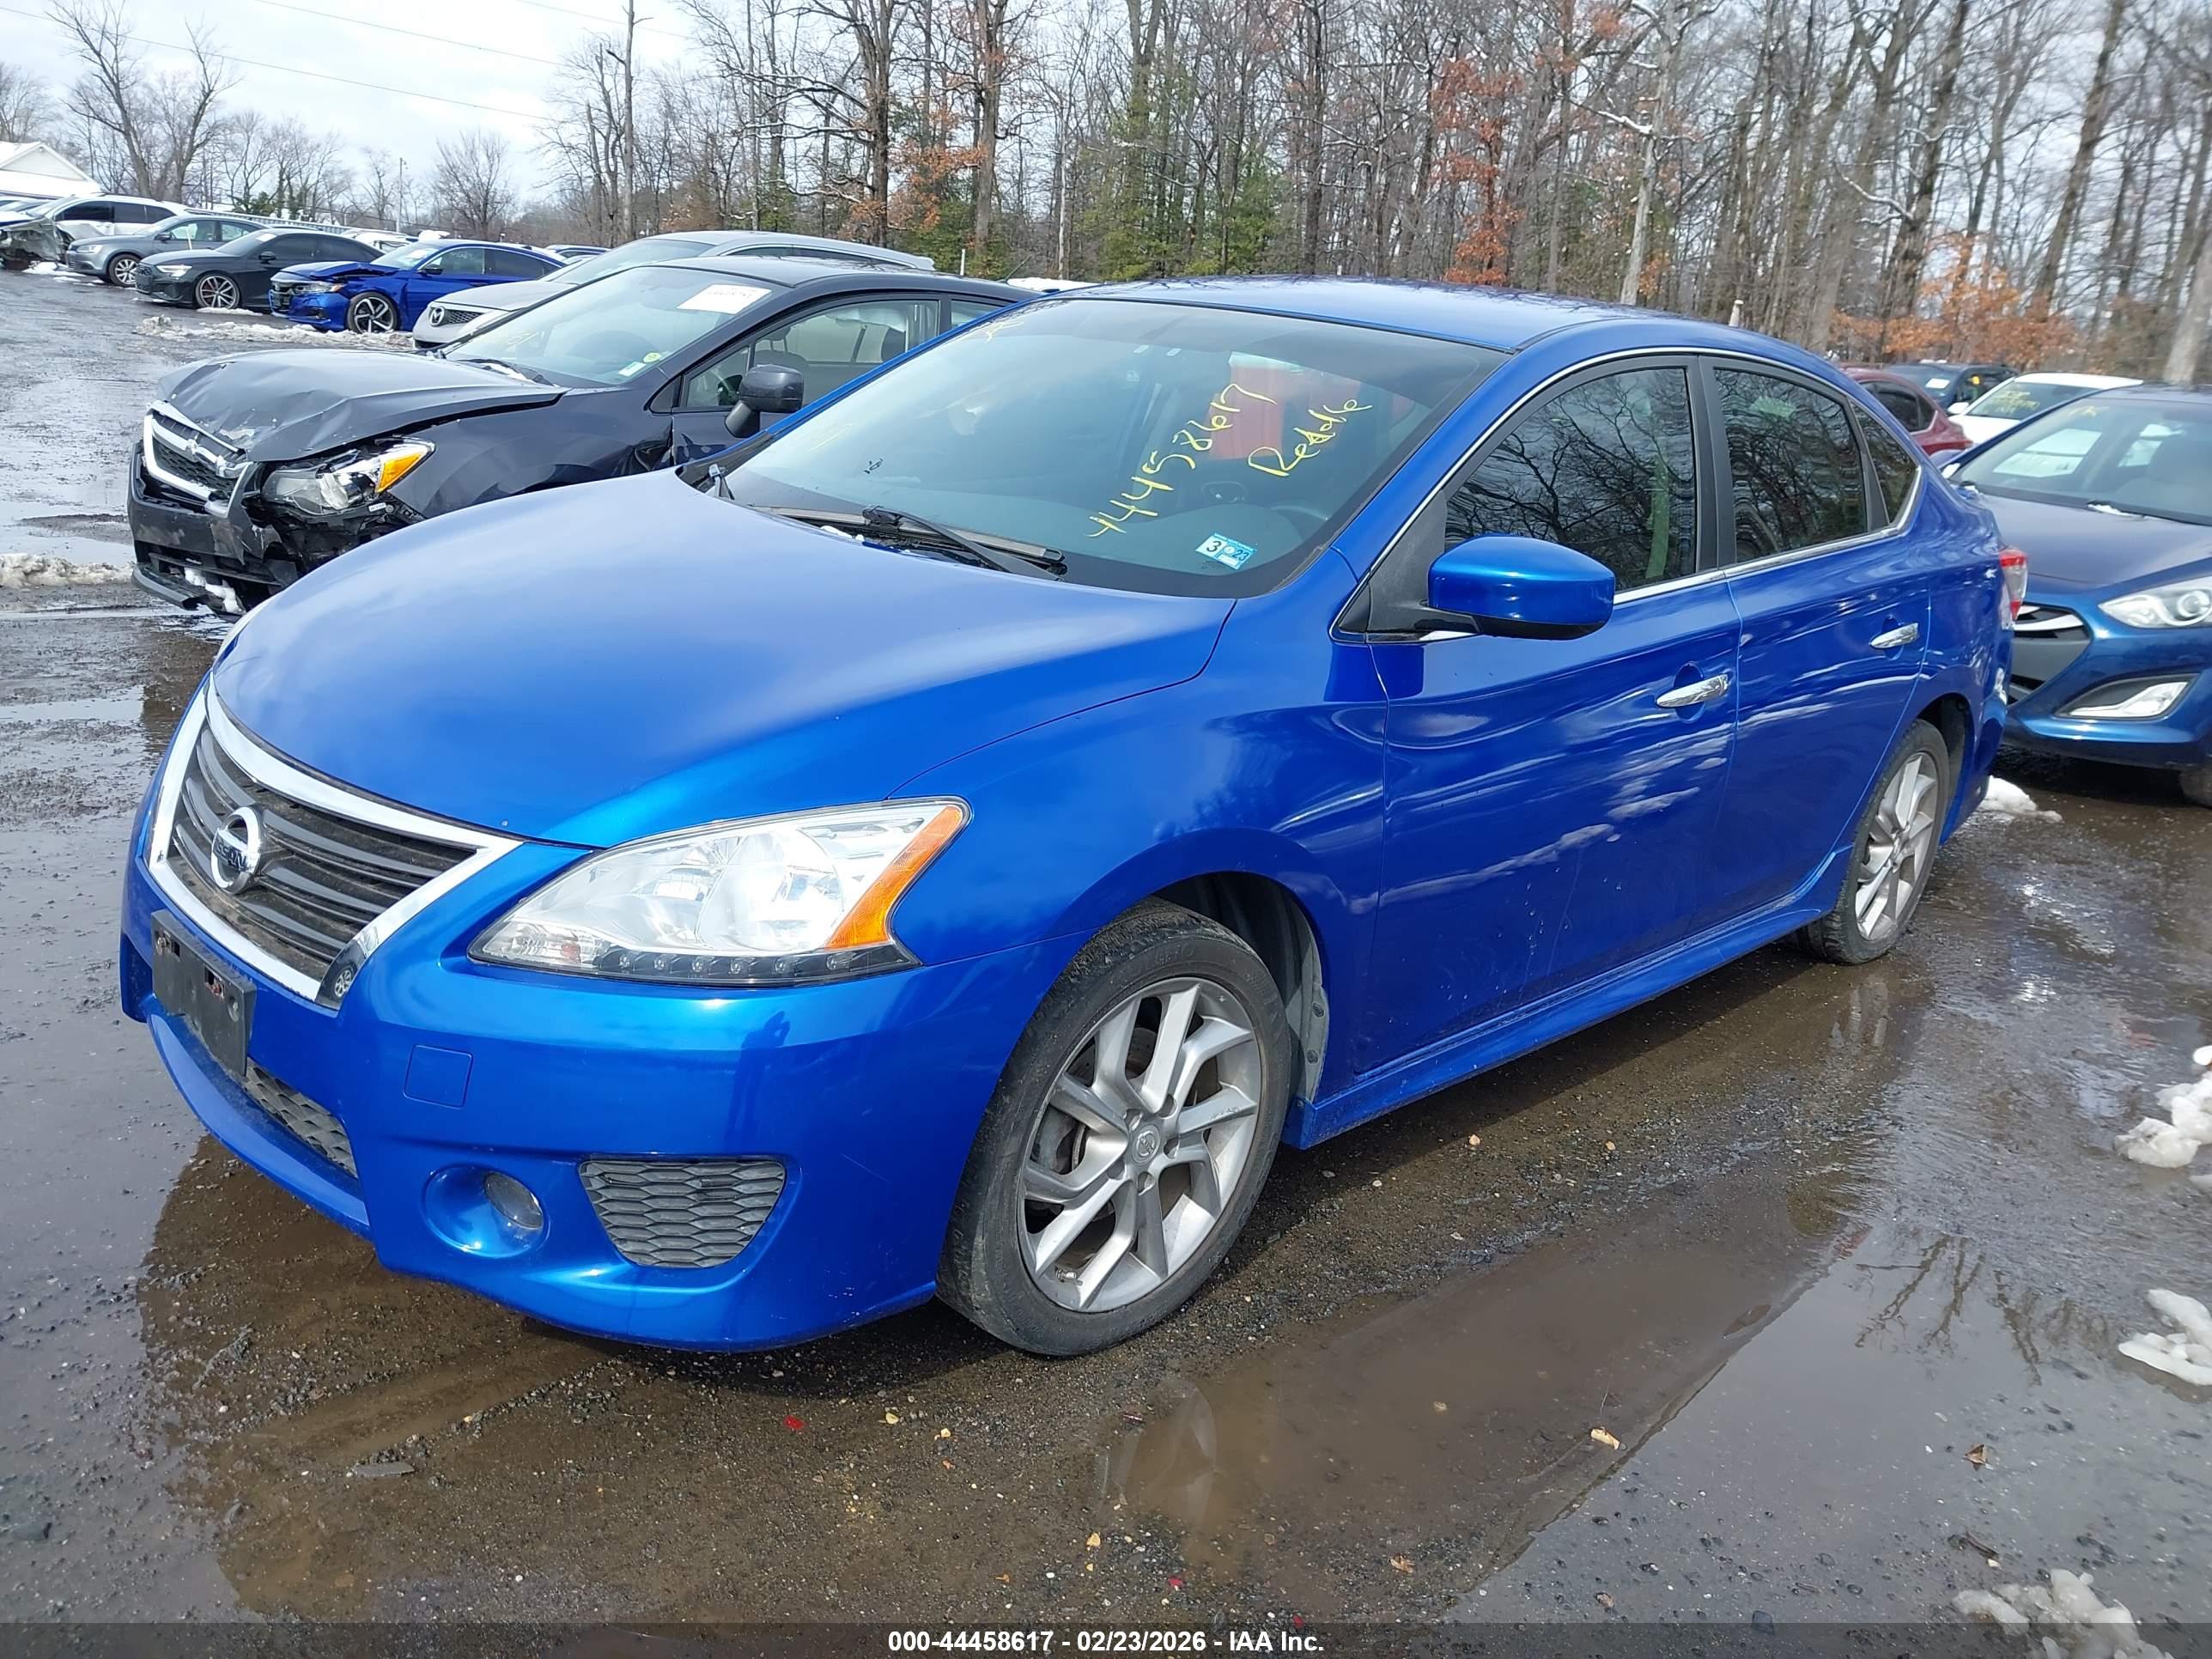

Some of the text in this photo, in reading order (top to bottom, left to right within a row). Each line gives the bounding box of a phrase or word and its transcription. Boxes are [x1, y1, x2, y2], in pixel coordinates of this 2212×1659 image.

[1085, 383, 1278, 538] 44458617
[1206, 540, 1222, 552] 3
[1231, 549, 1249, 561] 23
